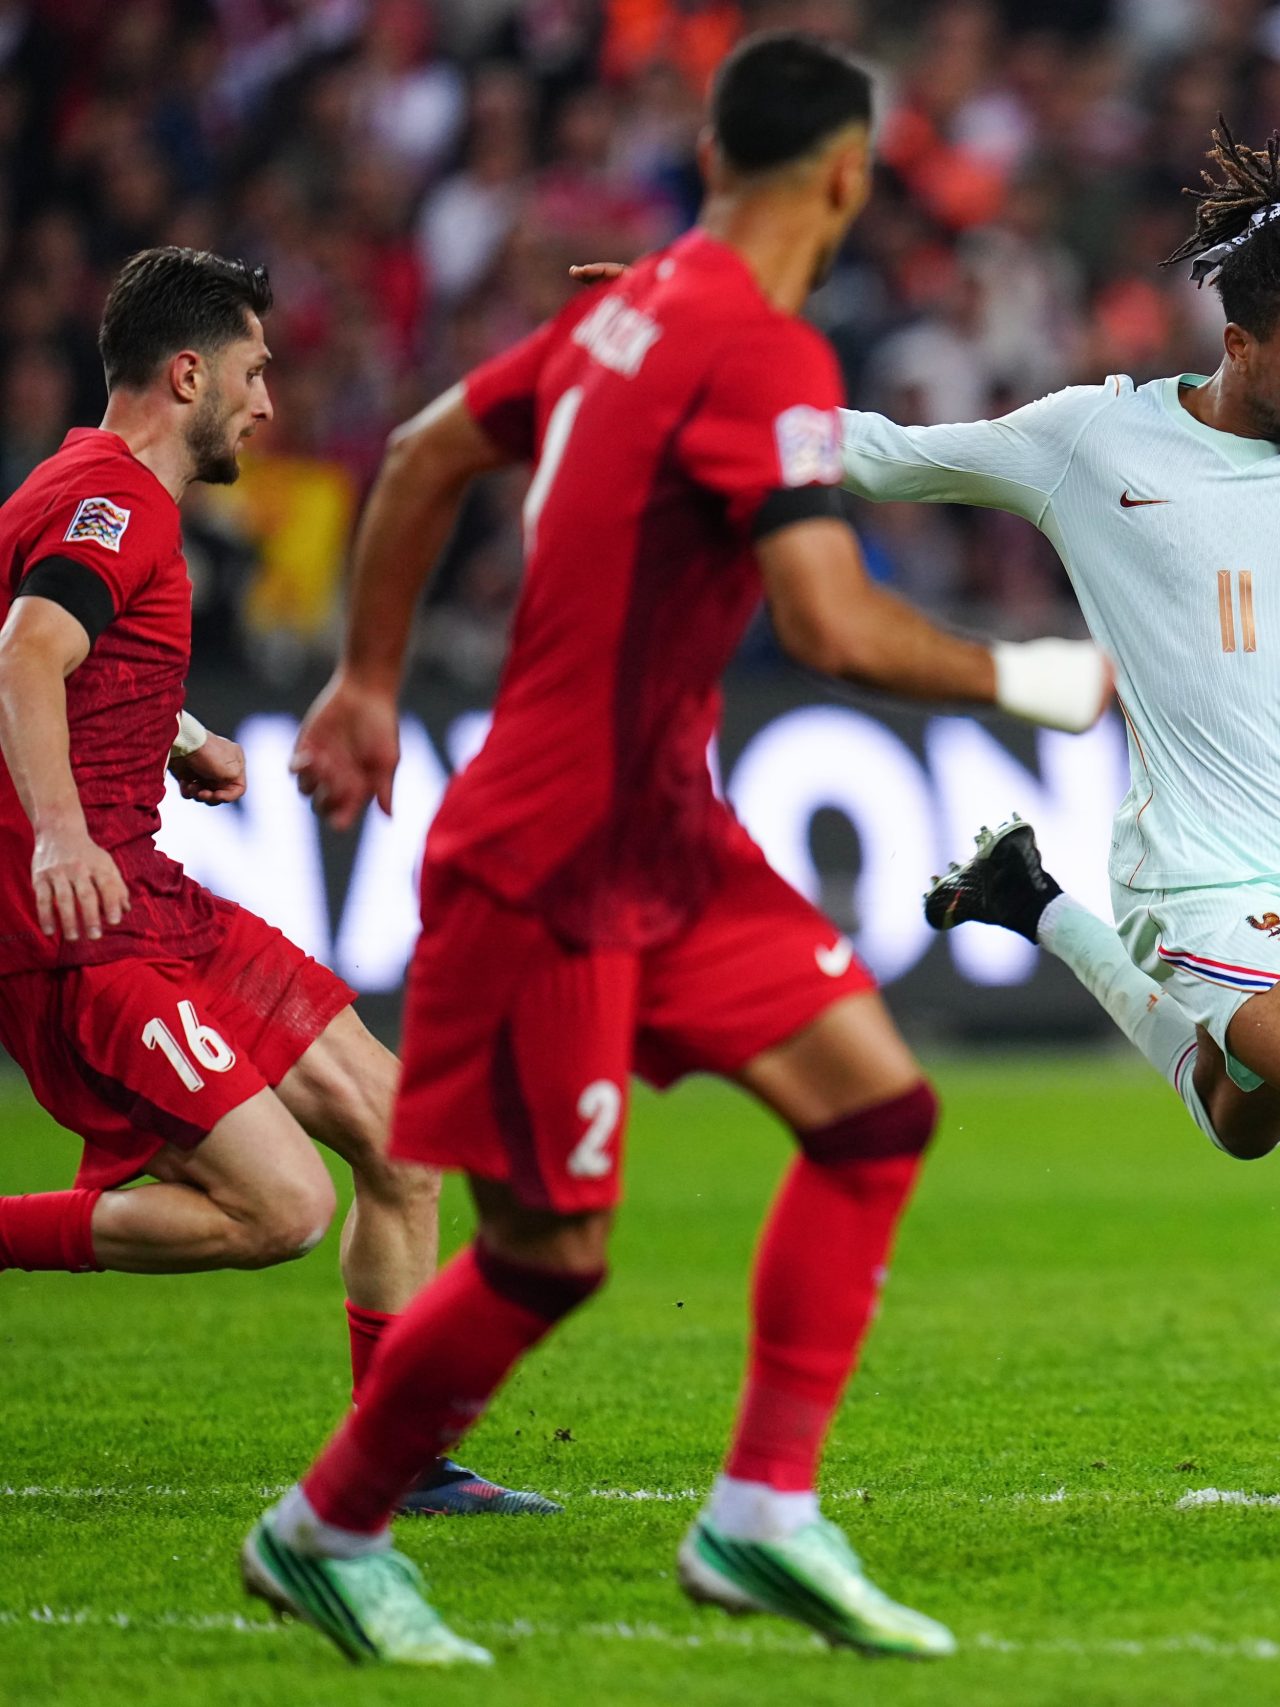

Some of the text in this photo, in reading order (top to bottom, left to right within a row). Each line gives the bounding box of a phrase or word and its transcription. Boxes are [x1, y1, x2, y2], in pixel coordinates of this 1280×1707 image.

[1217, 569, 1256, 653] 11
[141, 999, 236, 1092] 16
[566, 1078, 622, 1178] 2
